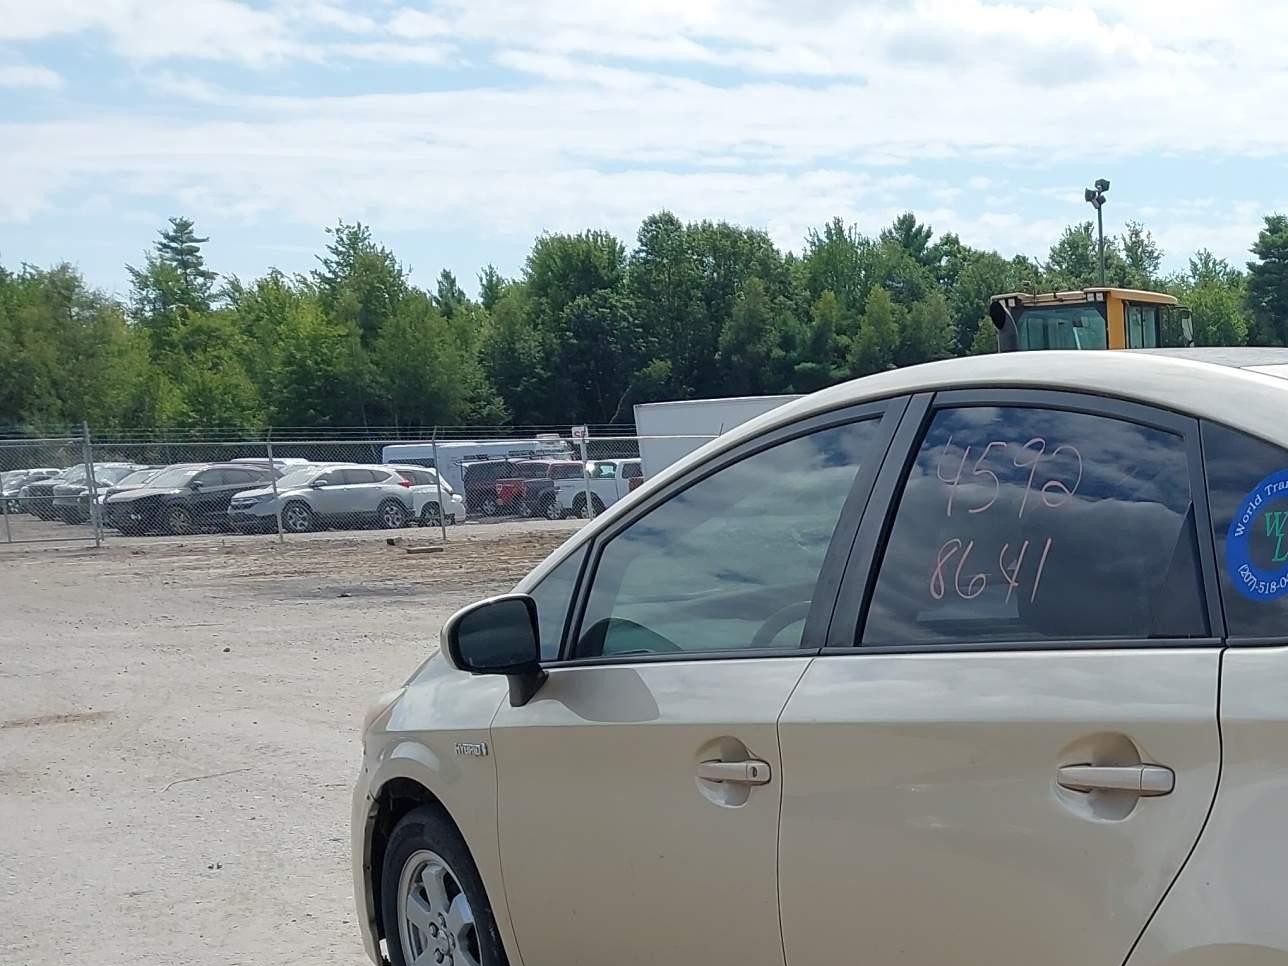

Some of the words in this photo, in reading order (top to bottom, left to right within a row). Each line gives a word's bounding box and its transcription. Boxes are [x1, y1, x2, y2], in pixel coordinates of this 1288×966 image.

[937, 435, 1084, 519] 4592
[1234, 494, 1263, 537] World
[930, 537, 1053, 604] 8641
